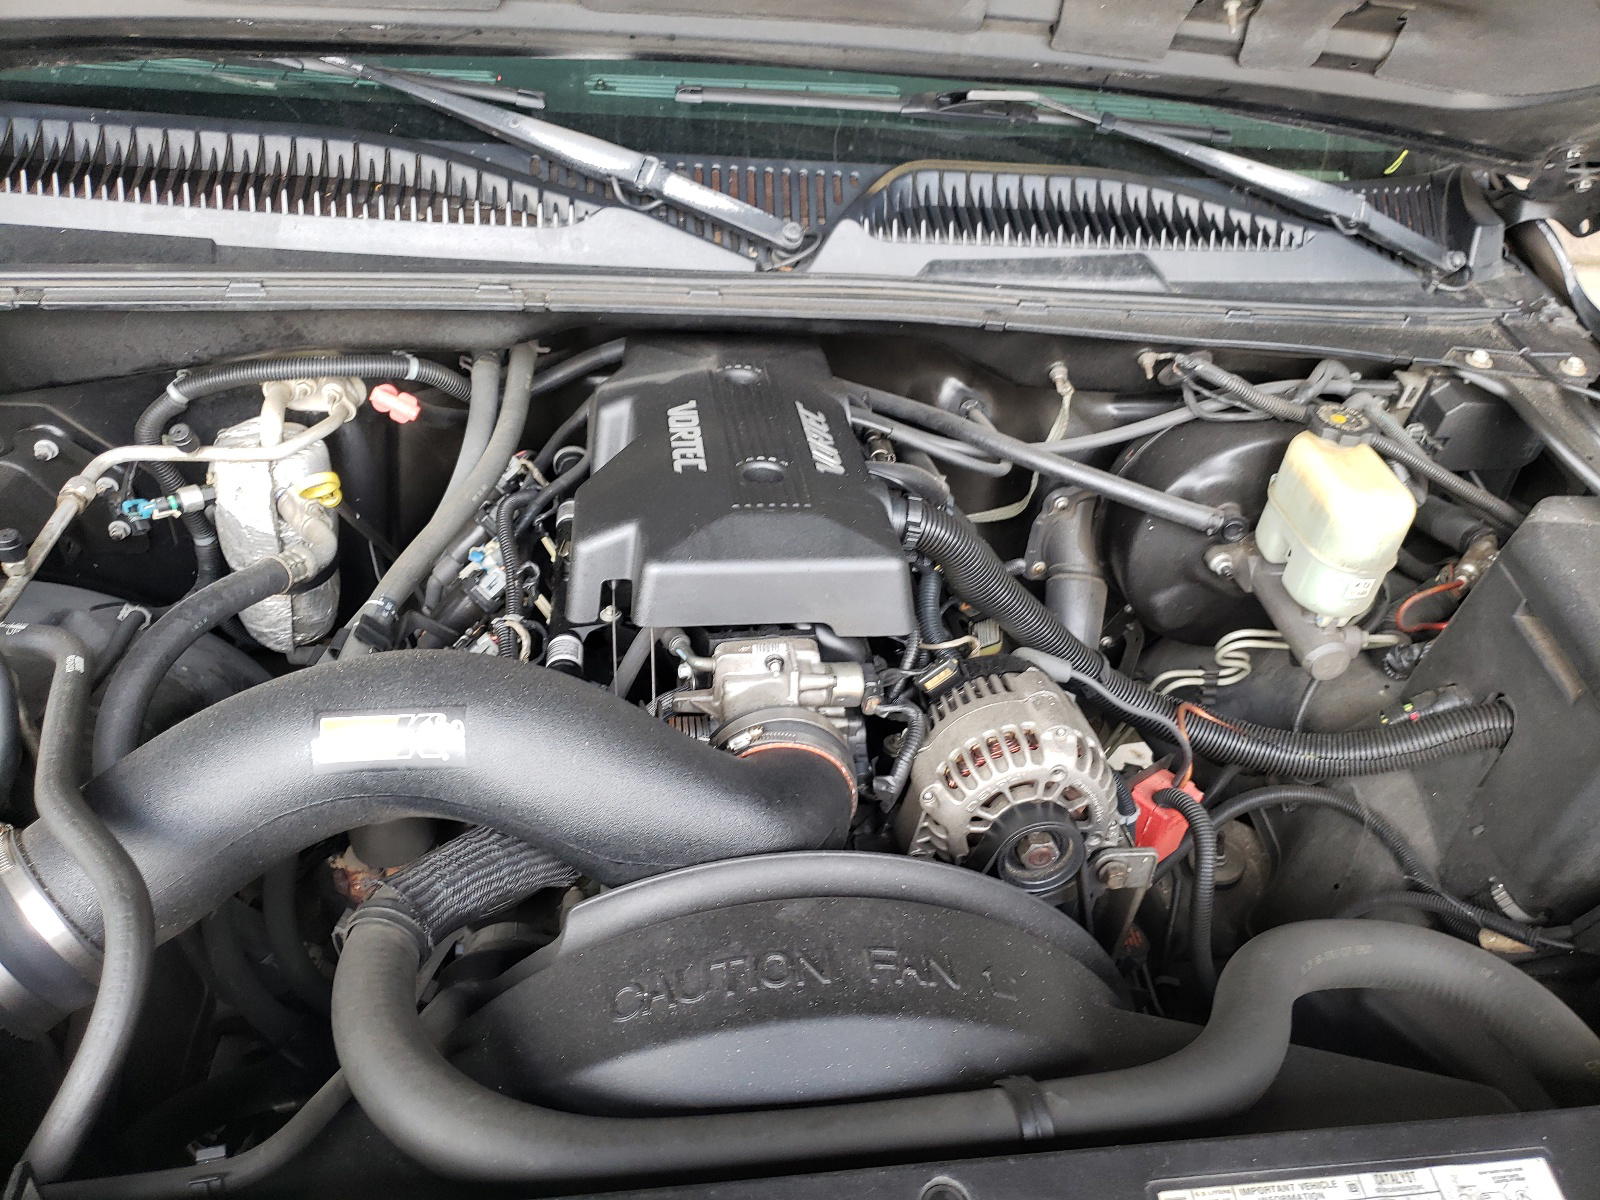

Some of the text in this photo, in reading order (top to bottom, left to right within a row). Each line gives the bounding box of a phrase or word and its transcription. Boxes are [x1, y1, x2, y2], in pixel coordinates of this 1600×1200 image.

[667, 400, 707, 474] VORTEC
[612, 950, 832, 1024] CAUTION
[864, 946, 962, 992] FAN
[1239, 1180, 1338, 1195] IMPORTANT VEHICLE
